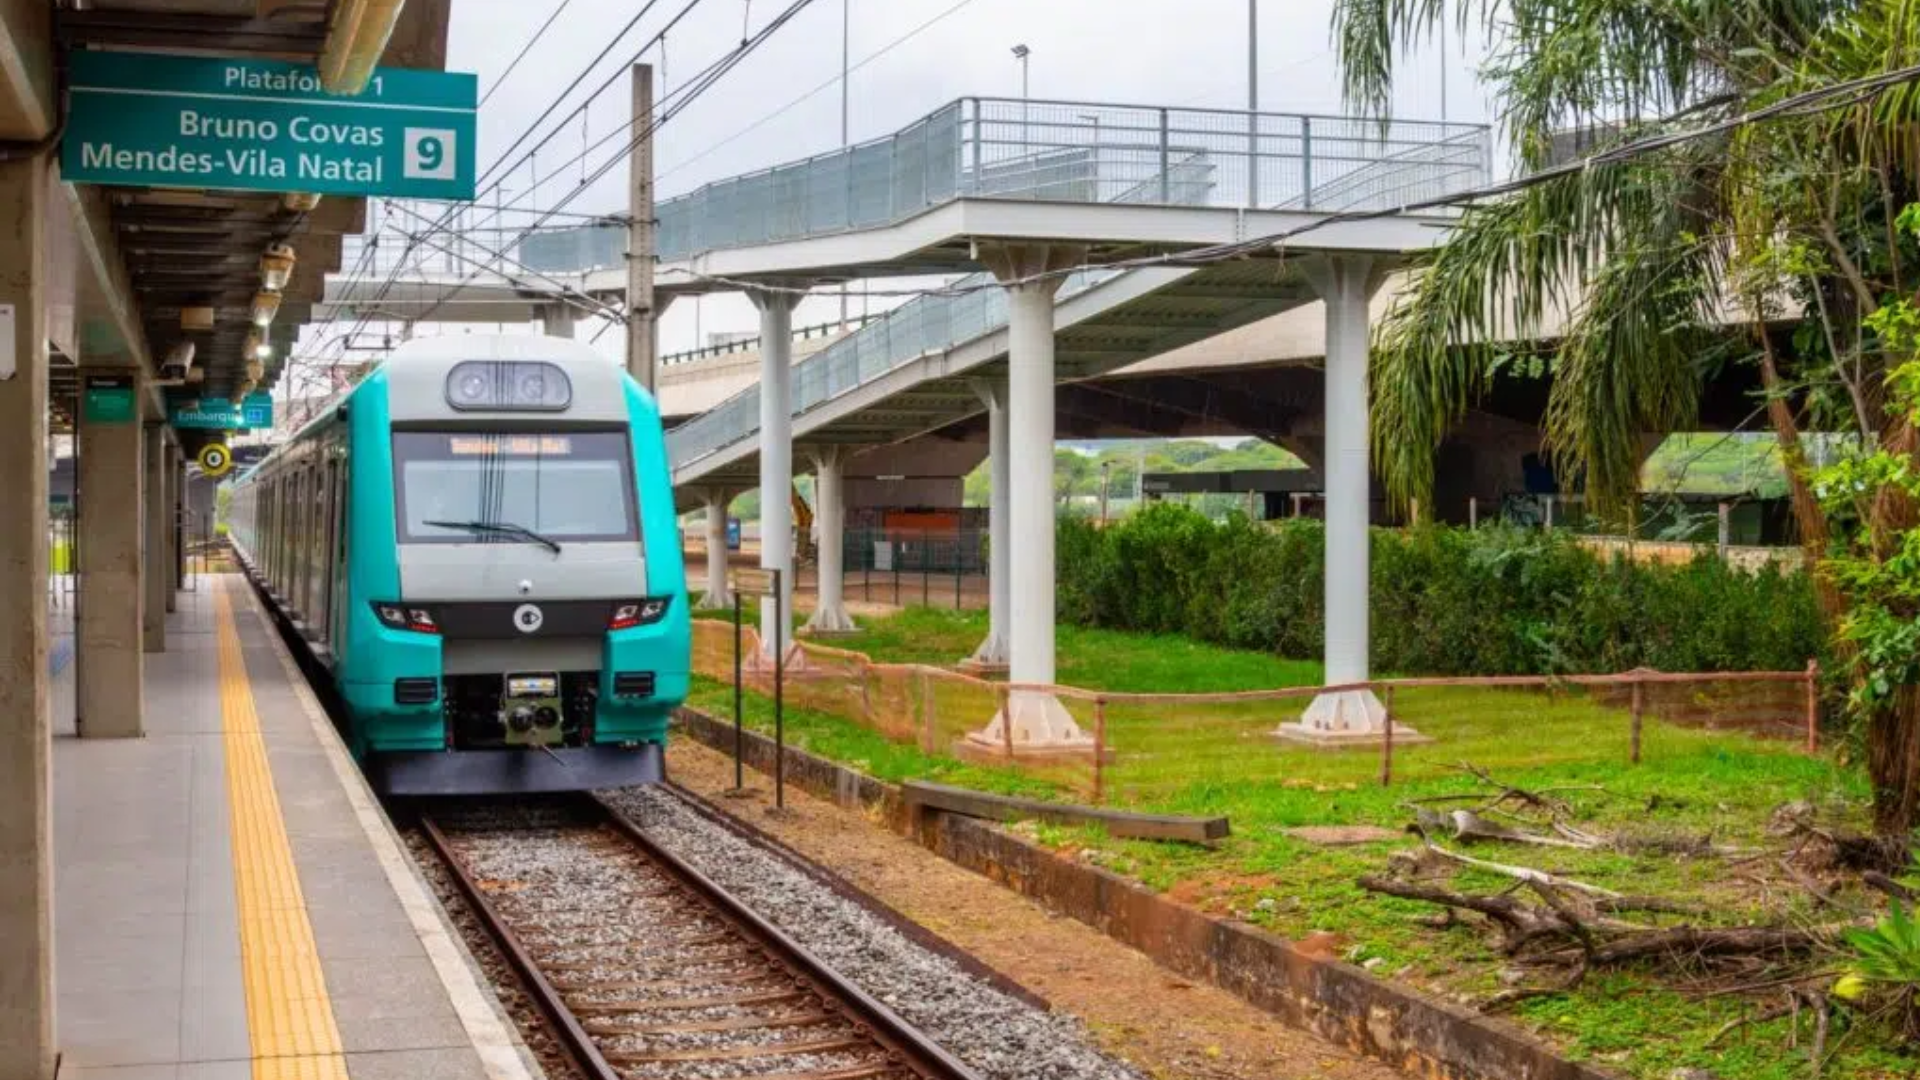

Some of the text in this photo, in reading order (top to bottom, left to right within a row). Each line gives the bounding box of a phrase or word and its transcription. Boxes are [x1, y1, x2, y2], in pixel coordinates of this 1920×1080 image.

[225, 66, 384, 96] Platafor 1
[180, 109, 384, 146] Bruno Covas
[81, 141, 383, 183] Mendes-Vila Natal
[416, 136, 443, 171] 9
[177, 411, 237, 424] Embarqu
